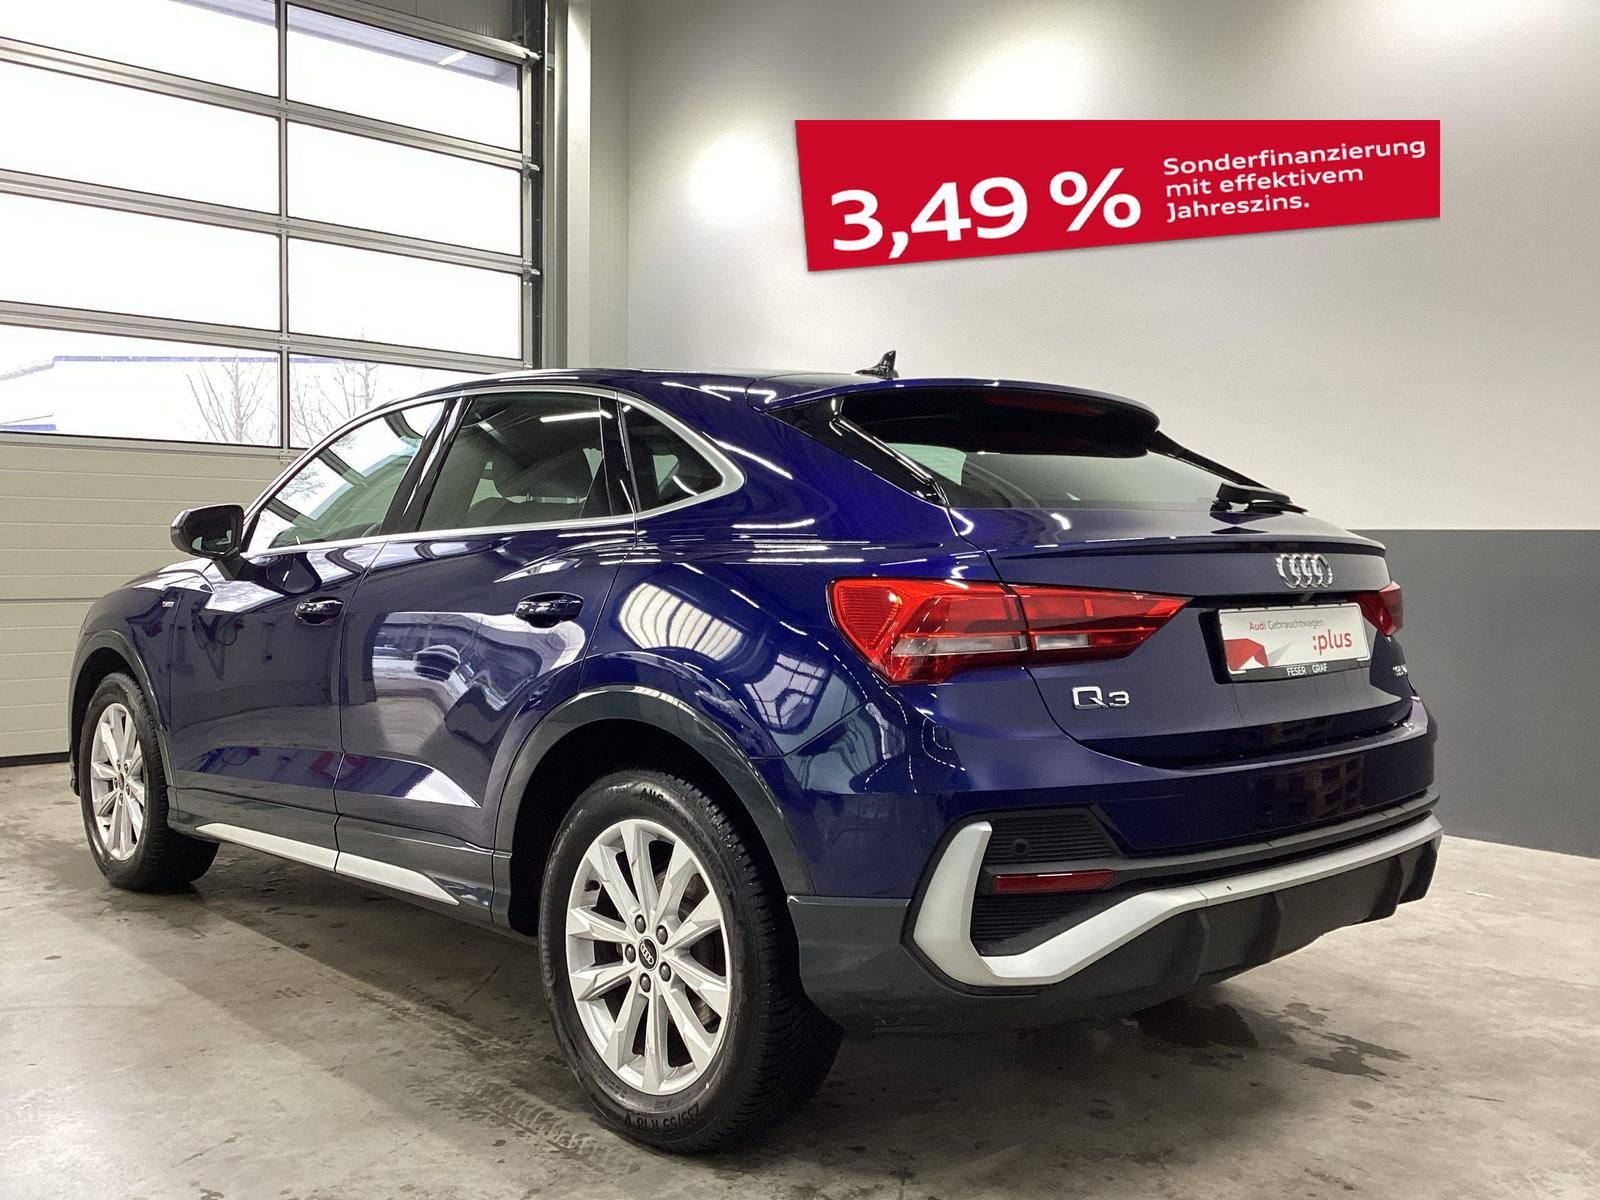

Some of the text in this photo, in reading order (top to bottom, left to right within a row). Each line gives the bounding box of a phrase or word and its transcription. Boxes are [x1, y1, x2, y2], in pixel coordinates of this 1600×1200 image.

[1249, 618, 1324, 631] Audi Gebrauchtwagen
[1313, 629, 1352, 655] :plus
[1287, 663, 1328, 677] FESER GRAF
[1072, 686, 1130, 710] Q3
